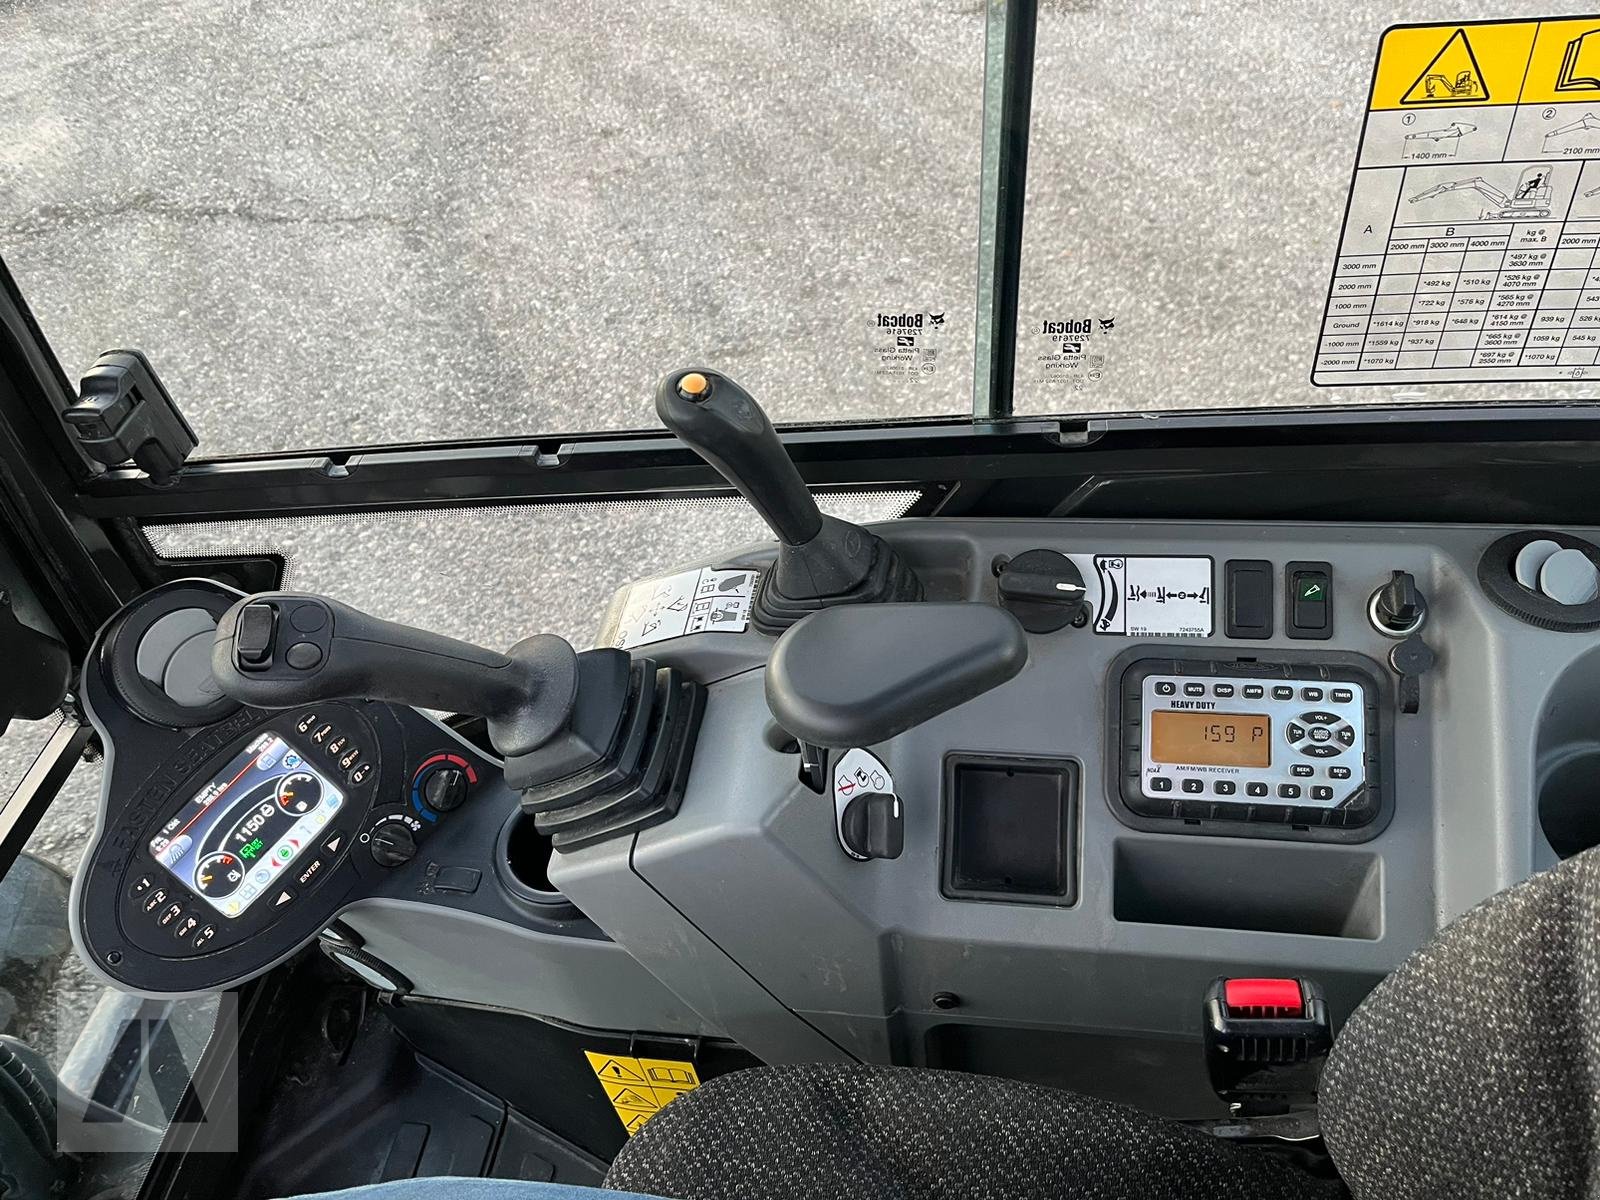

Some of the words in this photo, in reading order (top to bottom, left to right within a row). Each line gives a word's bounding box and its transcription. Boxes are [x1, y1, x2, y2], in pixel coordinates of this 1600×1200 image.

[1363, 225, 1373, 234] A
[1445, 227, 1455, 236] B
[1435, 299, 1446, 307] kg
[1474, 298, 1485, 306] kg
[1389, 339, 1399, 347] kg
[1170, 700, 1195, 709] HEAVY
[1195, 701, 1216, 710] DUTY
[298, 721, 308, 733] 6
[313, 731, 323, 743] 7
[329, 742, 339, 754] 8
[341, 757, 352, 769] 9
[1190, 782, 1197, 791] 2
[1222, 784, 1229, 792] 3
[1254, 786, 1261, 794] 4
[1288, 787, 1294, 795] 5
[1320, 788, 1326, 797] 6
[235, 814, 265, 842] 1150
[299, 860, 321, 884] ENTER
[142, 878, 151, 888] 1
[154, 890, 167, 903] 2
[170, 904, 181, 917] 3
[187, 917, 197, 929] 4
[203, 926, 215, 939] 5
